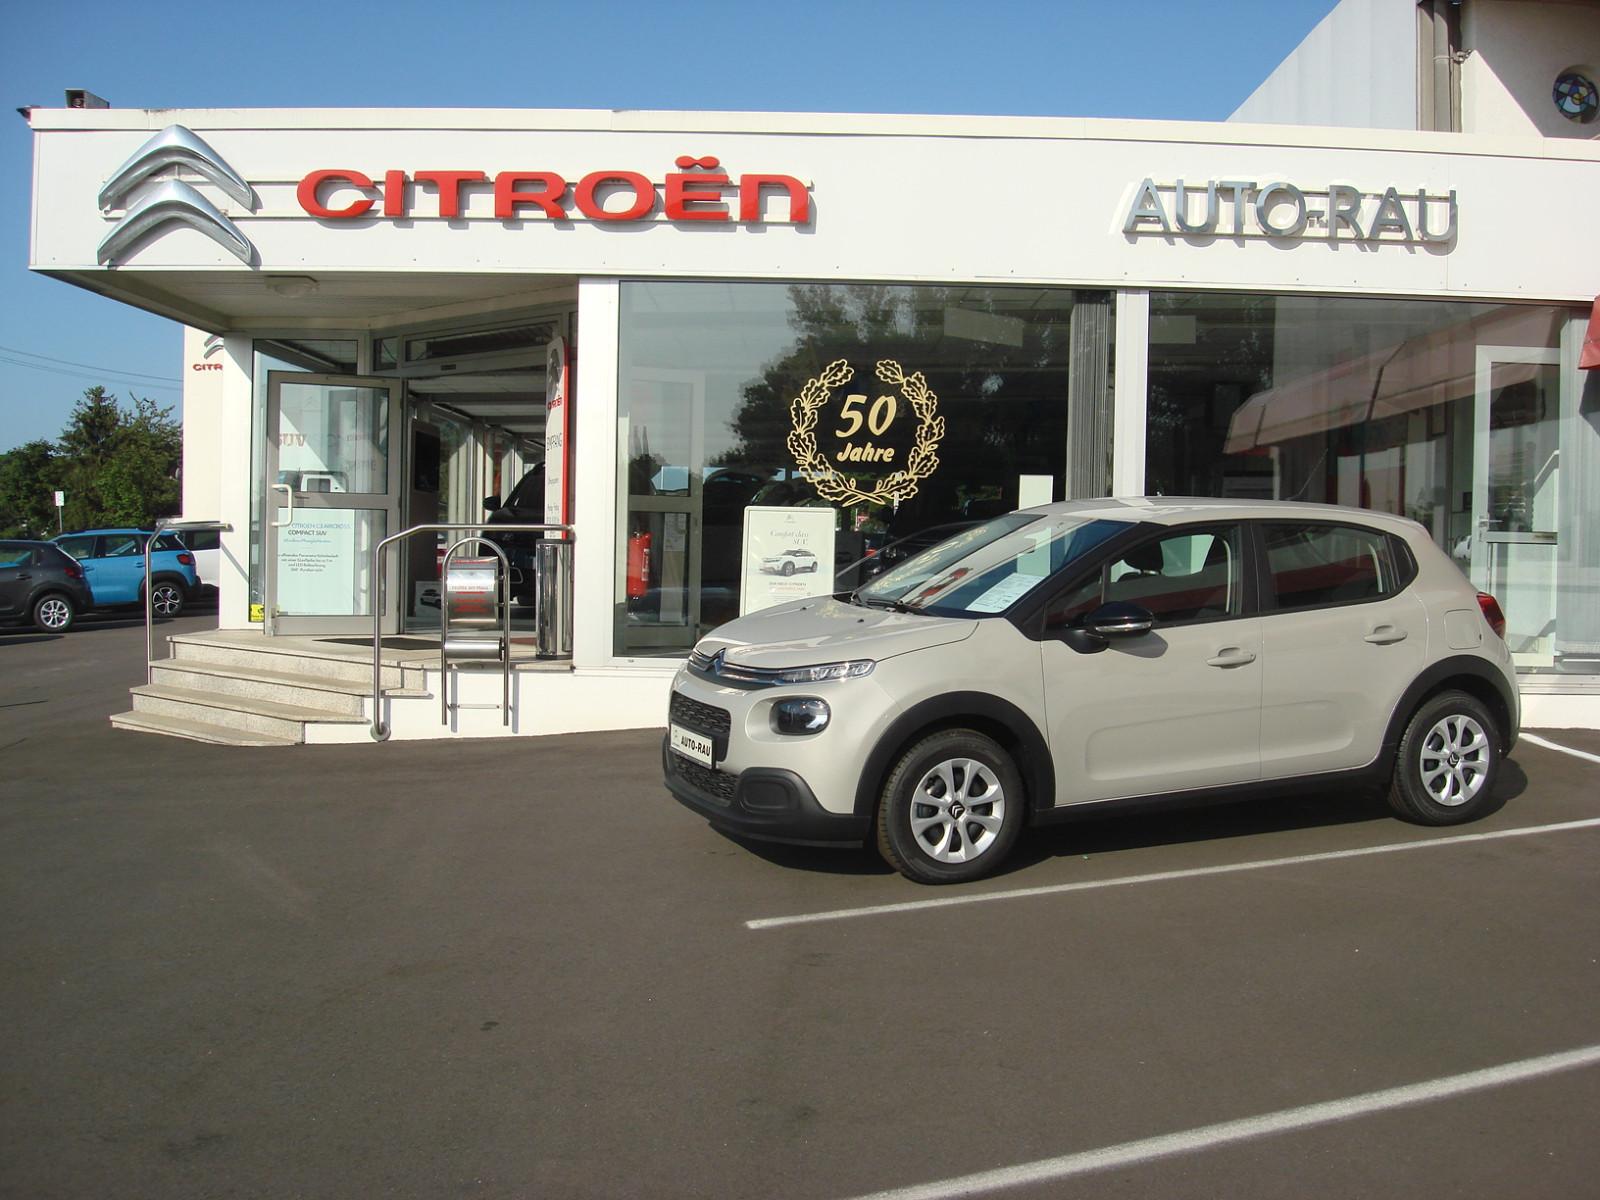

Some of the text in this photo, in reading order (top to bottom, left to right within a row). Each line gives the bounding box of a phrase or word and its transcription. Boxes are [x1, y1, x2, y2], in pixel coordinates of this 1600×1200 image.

[297, 155, 809, 223] CITROËN
[1122, 177, 1457, 242] AUTO-RAU
[835, 394, 897, 438] 50
[836, 442, 895, 462] Jahre
